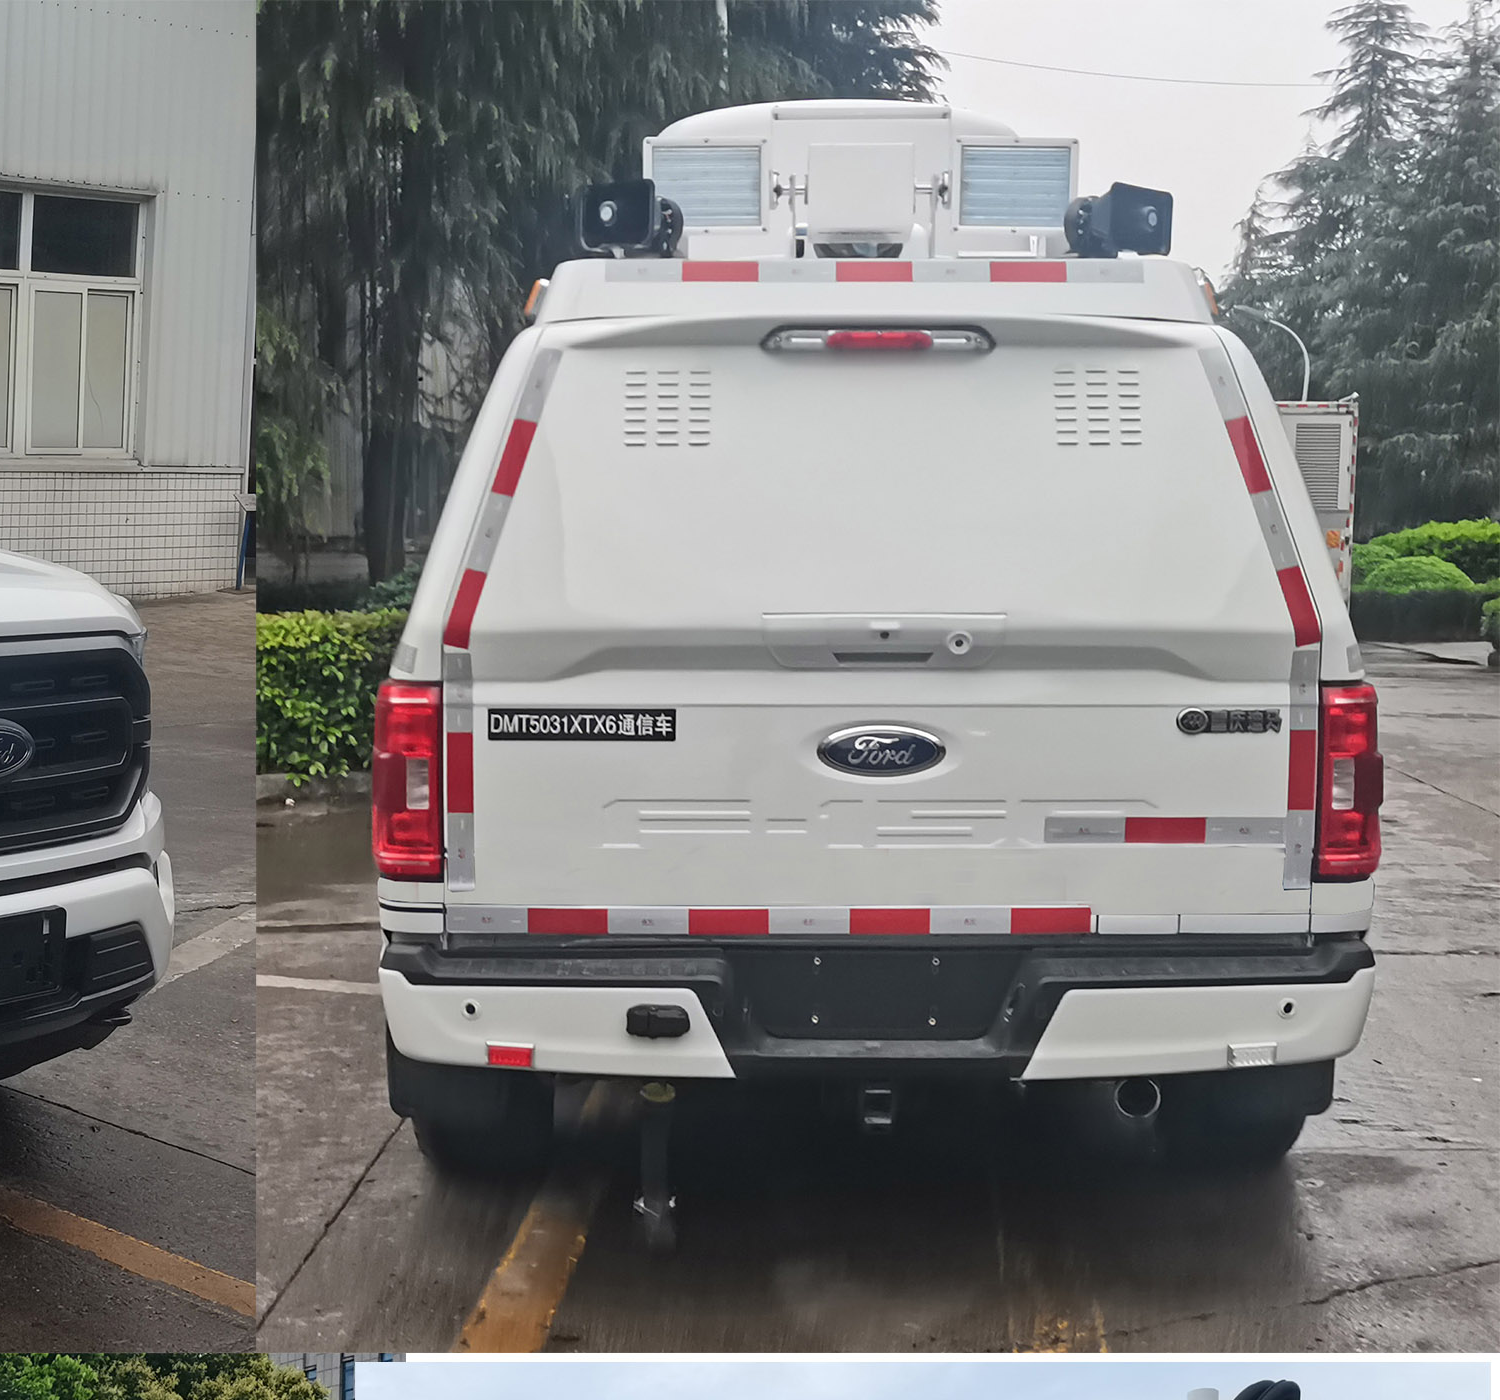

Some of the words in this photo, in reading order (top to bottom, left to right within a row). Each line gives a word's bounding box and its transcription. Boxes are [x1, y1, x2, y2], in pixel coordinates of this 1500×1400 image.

[490, 713, 673, 737] DMT5031XTX6通信车
[848, 736, 917, 765] Ford
